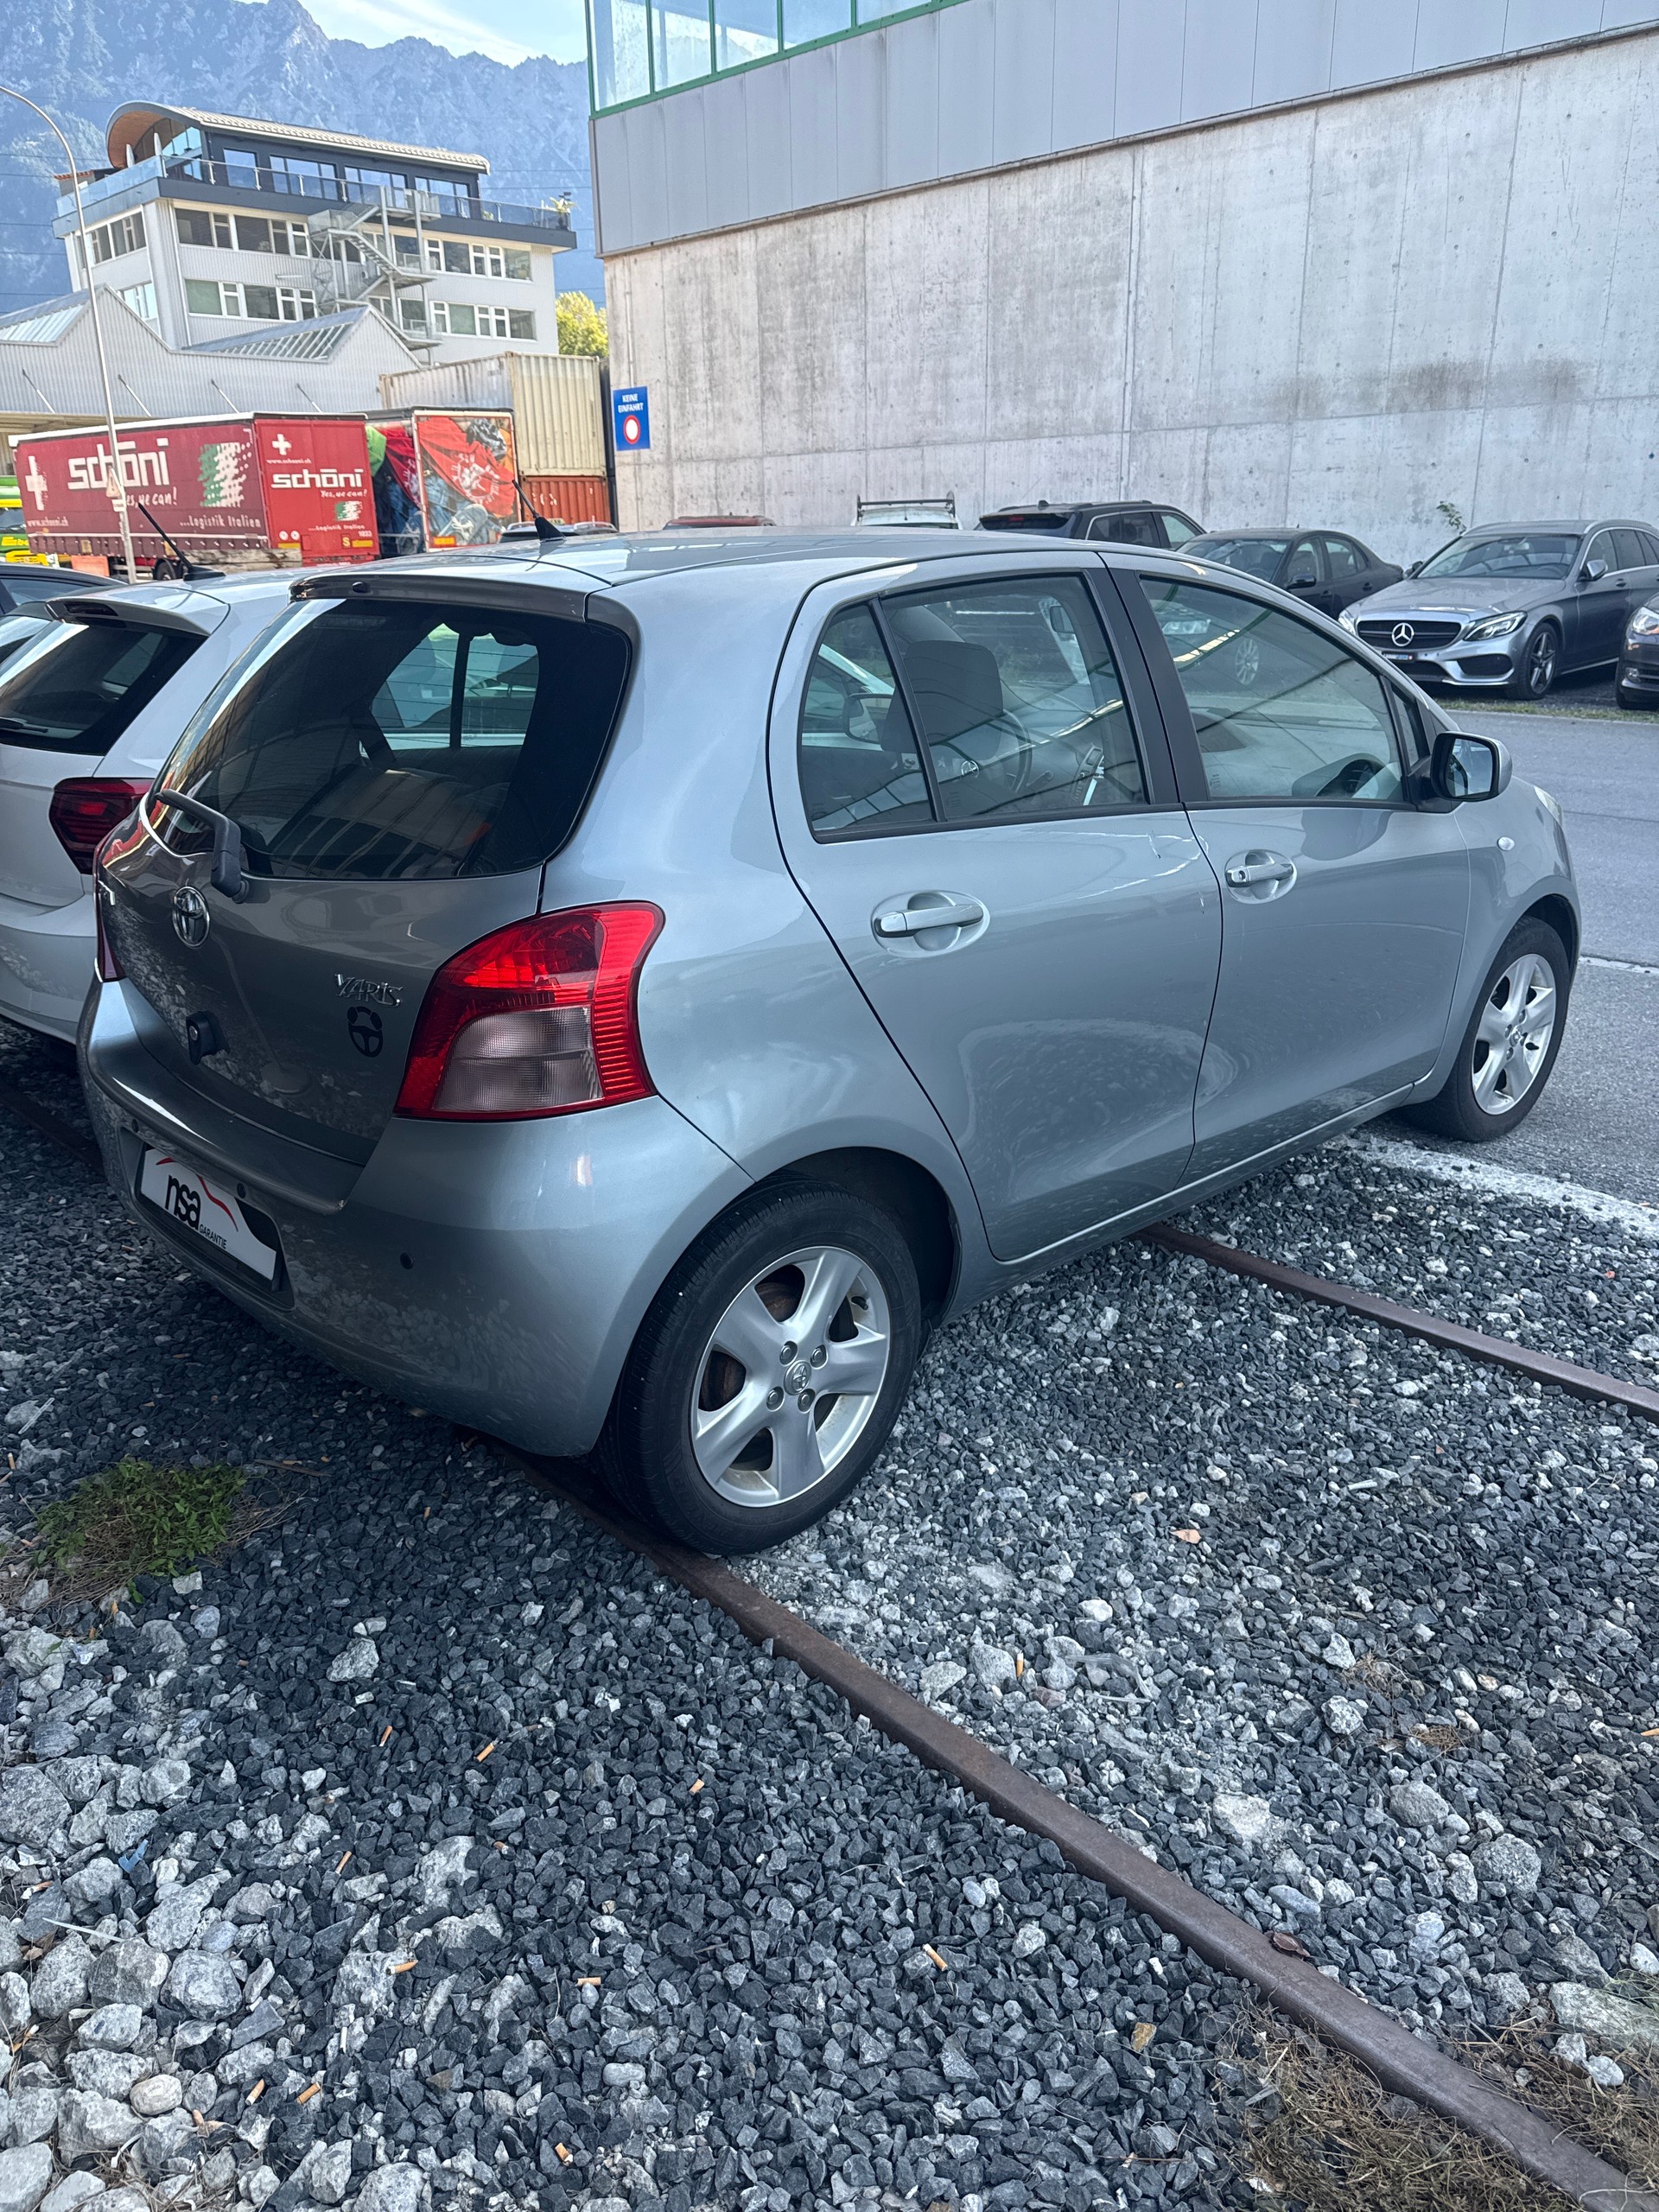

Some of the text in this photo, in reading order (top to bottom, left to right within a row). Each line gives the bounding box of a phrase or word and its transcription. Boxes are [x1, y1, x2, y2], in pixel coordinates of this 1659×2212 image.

[618, 403, 644, 413] EINFAHRT
[622, 393, 638, 403] KEINE
[270, 468, 364, 489] schöni
[227, 514, 262, 529] Italien
[334, 974, 404, 1008] YARIS
[165, 1174, 201, 1230] nsa
[199, 1224, 227, 1250] GARANTIE
